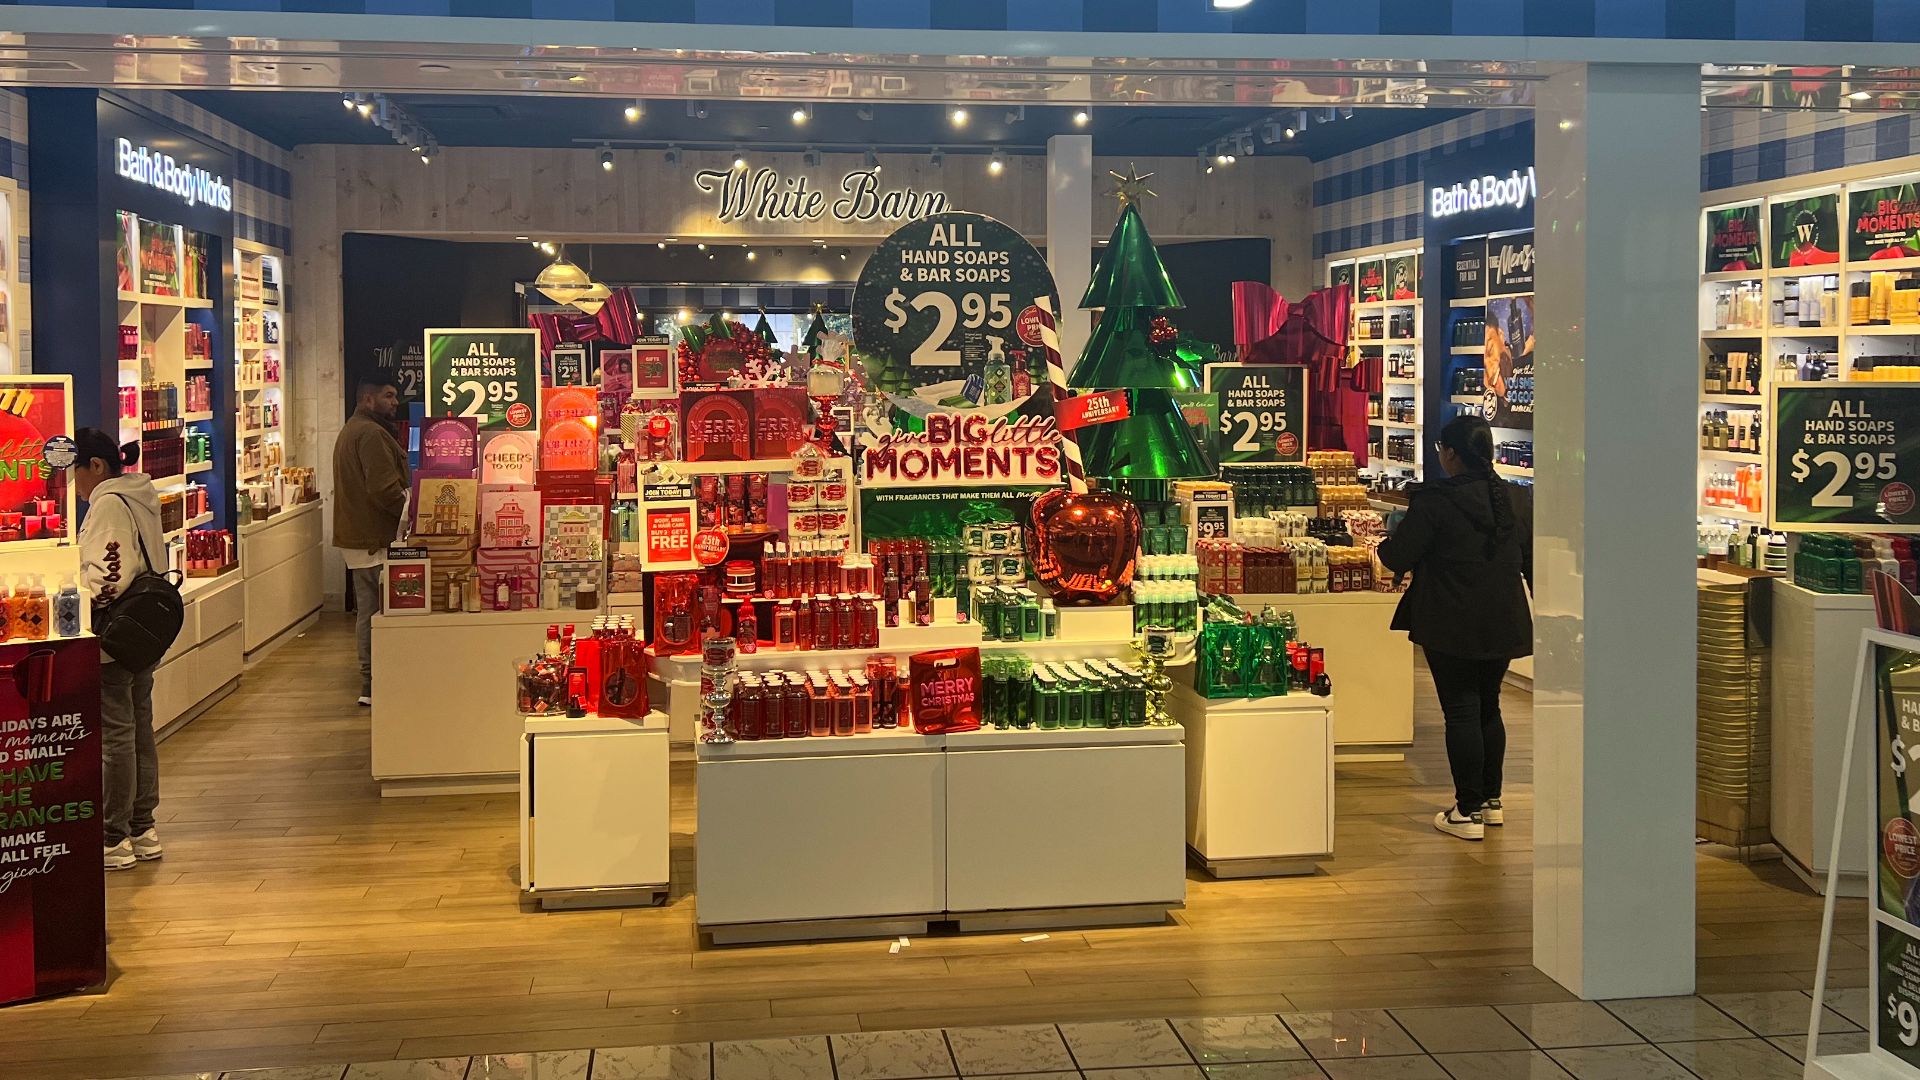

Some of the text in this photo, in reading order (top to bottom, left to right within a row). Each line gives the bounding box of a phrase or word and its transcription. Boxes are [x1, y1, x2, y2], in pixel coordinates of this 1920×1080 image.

[119, 137, 232, 212] Bath & Body Works
[696, 168, 950, 220] White Barn
[1431, 183, 1468, 219] Bath
[1469, 178, 1482, 211] &
[1482, 170, 1529, 209] Body
[1878, 199, 1899, 215] BIG
[1857, 213, 1920, 233] MOMENTS
[929, 223, 981, 247] ALL
[901, 250, 1009, 265] HAND SOAPS
[900, 267, 1011, 283] & BAR SOAPS
[1020, 316, 1039, 325] LOW
[467, 342, 499, 357] ALL
[451, 357, 516, 368] HAND SOAPS
[450, 368, 517, 377] & BAR SOAPS
[1242, 375, 1270, 388] ALL
[1518, 376, 1534, 389] SME
[1228, 389, 1285, 398] HAND SOAPS
[1518, 391, 1534, 403] GOO
[1086, 395, 1110, 411] 25th
[1227, 399, 1286, 407] & BAR SOAPS
[1828, 400, 1871, 418] ALL
[1081, 405, 1120, 420] ANNIVERSARY
[759, 417, 802, 432] ERRY
[1805, 420, 1895, 432] HAND SOAPS
[757, 431, 802, 441] RISTMAS
[878, 413, 1062, 455] give BIG little
[1803, 433, 1896, 445] & BAR SOAPS
[425, 446, 473, 457] WISHES
[484, 453, 532, 463] CHEERS
[866, 446, 1060, 481] MOMENTS
[876, 494, 894, 502] WITH
[895, 493, 941, 501] FRAGRANCES
[960, 492, 980, 500] MAKE
[1002, 491, 1015, 499] ALL
[651, 534, 689, 550] FREE
[702, 534, 720, 546] 25th
[920, 677, 974, 697] MERRY
[921, 692, 975, 706] CHRISTMAS
[1902, 698, 1920, 716] HA
[0, 712, 82, 733] IDAYS ARE
[5, 722, 93, 748] moments
[0, 761, 65, 785] HAVE
[0, 786, 33, 809] HE
[0, 830, 46, 848] MAKE
[0, 843, 71, 864] ALL FEEL
[0, 852, 56, 894] gical
[1905, 942, 1920, 959] AL
